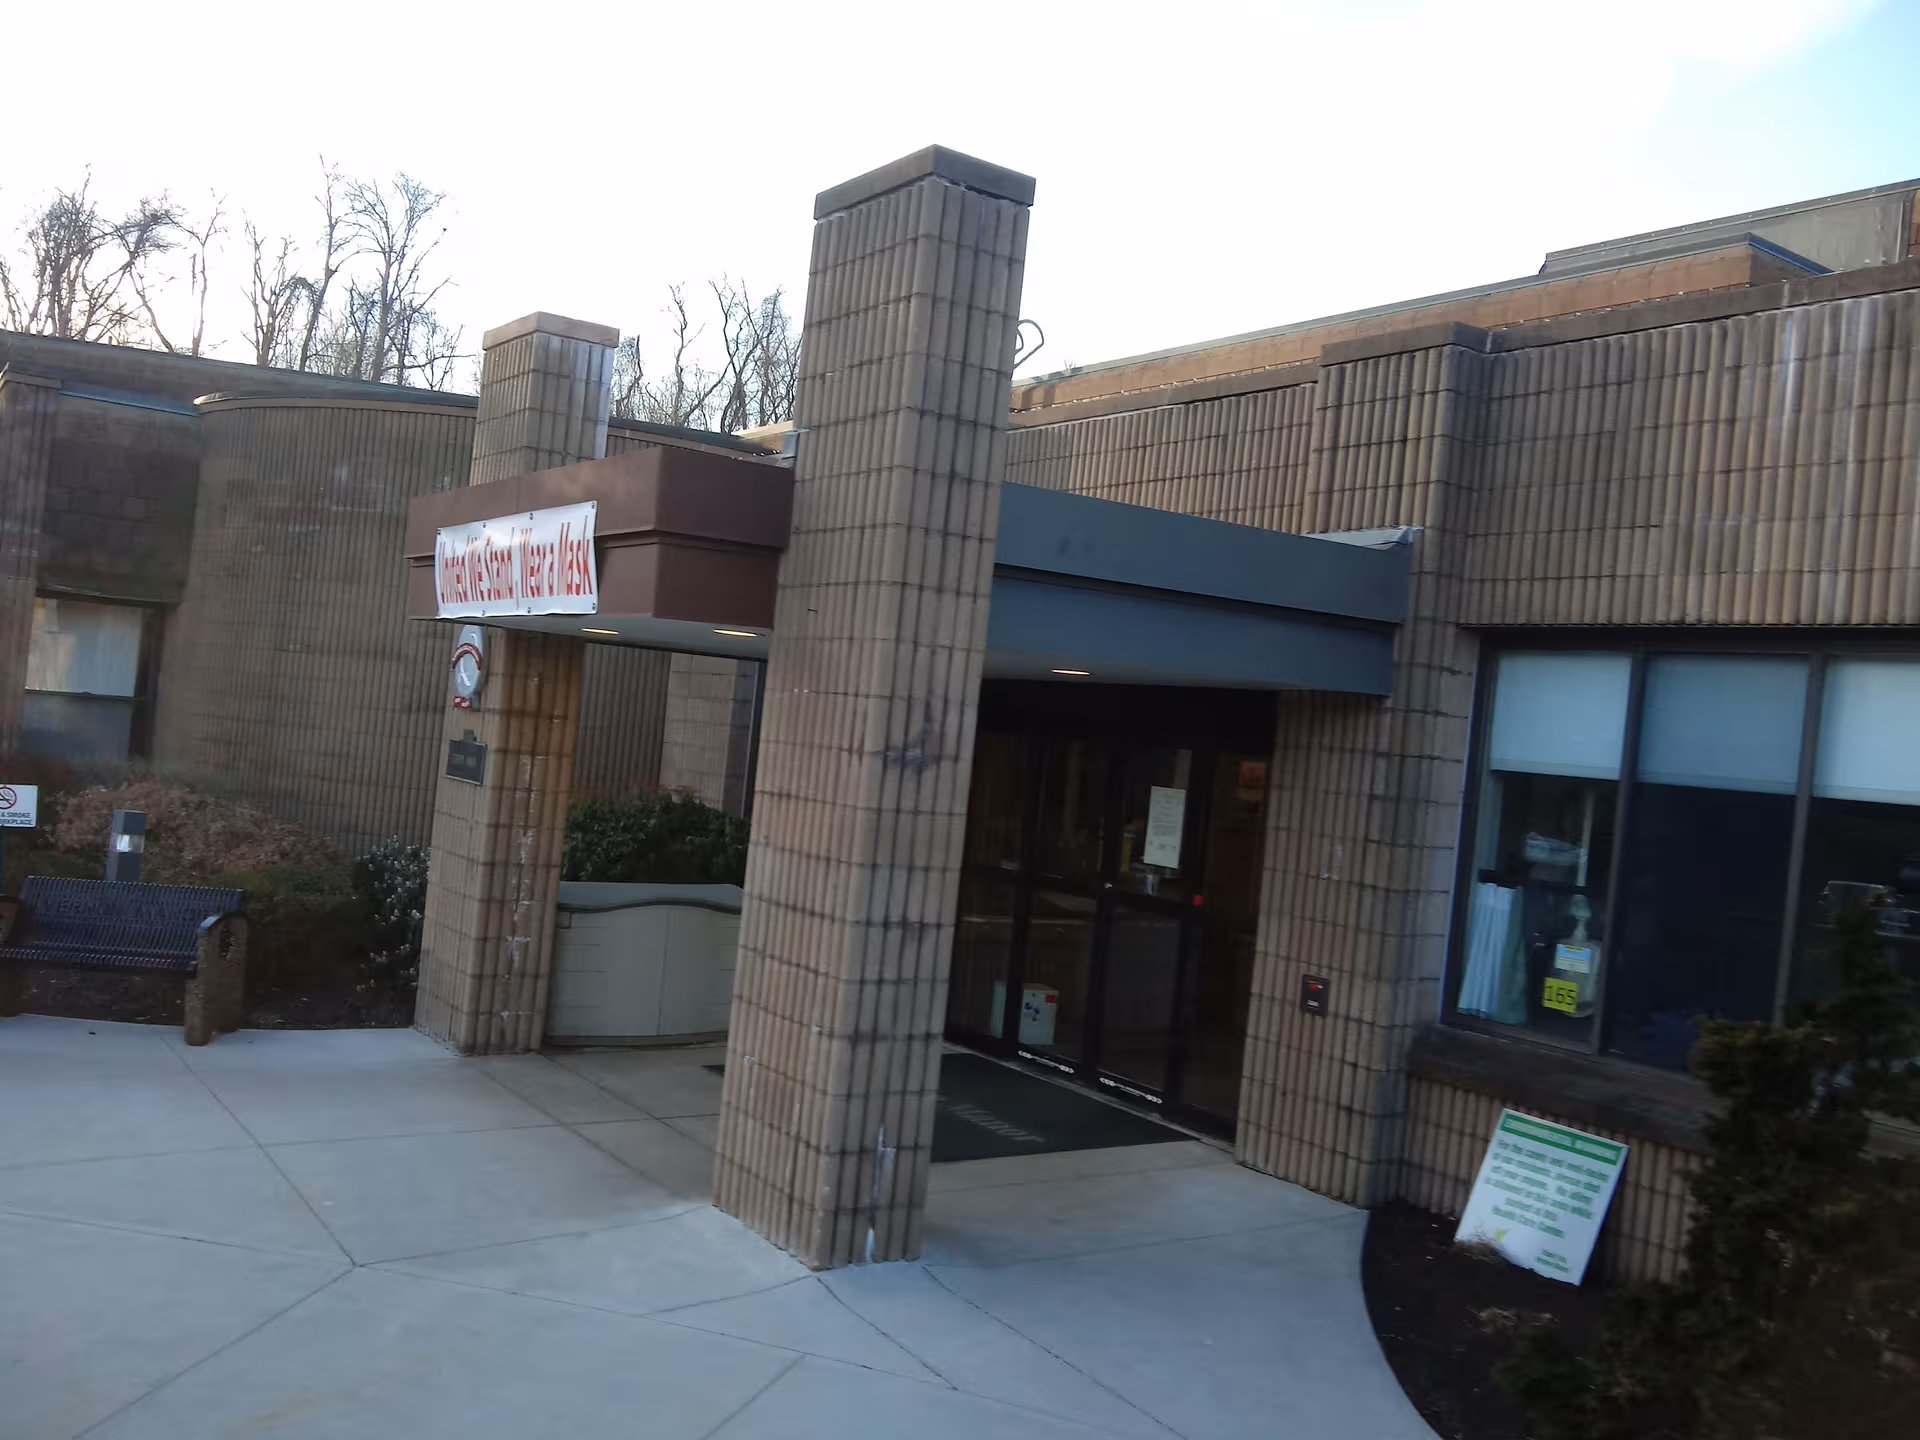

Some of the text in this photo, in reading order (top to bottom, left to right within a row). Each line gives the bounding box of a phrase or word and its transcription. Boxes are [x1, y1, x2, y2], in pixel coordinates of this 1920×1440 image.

[439, 535, 470, 604] United
[468, 536, 485, 601] We
[520, 528, 546, 598] Wear
[548, 542, 554, 597] a
[557, 515, 594, 597] Mask
[6, 811, 31, 819] SMOKE
[1543, 985, 1576, 1006] 165
